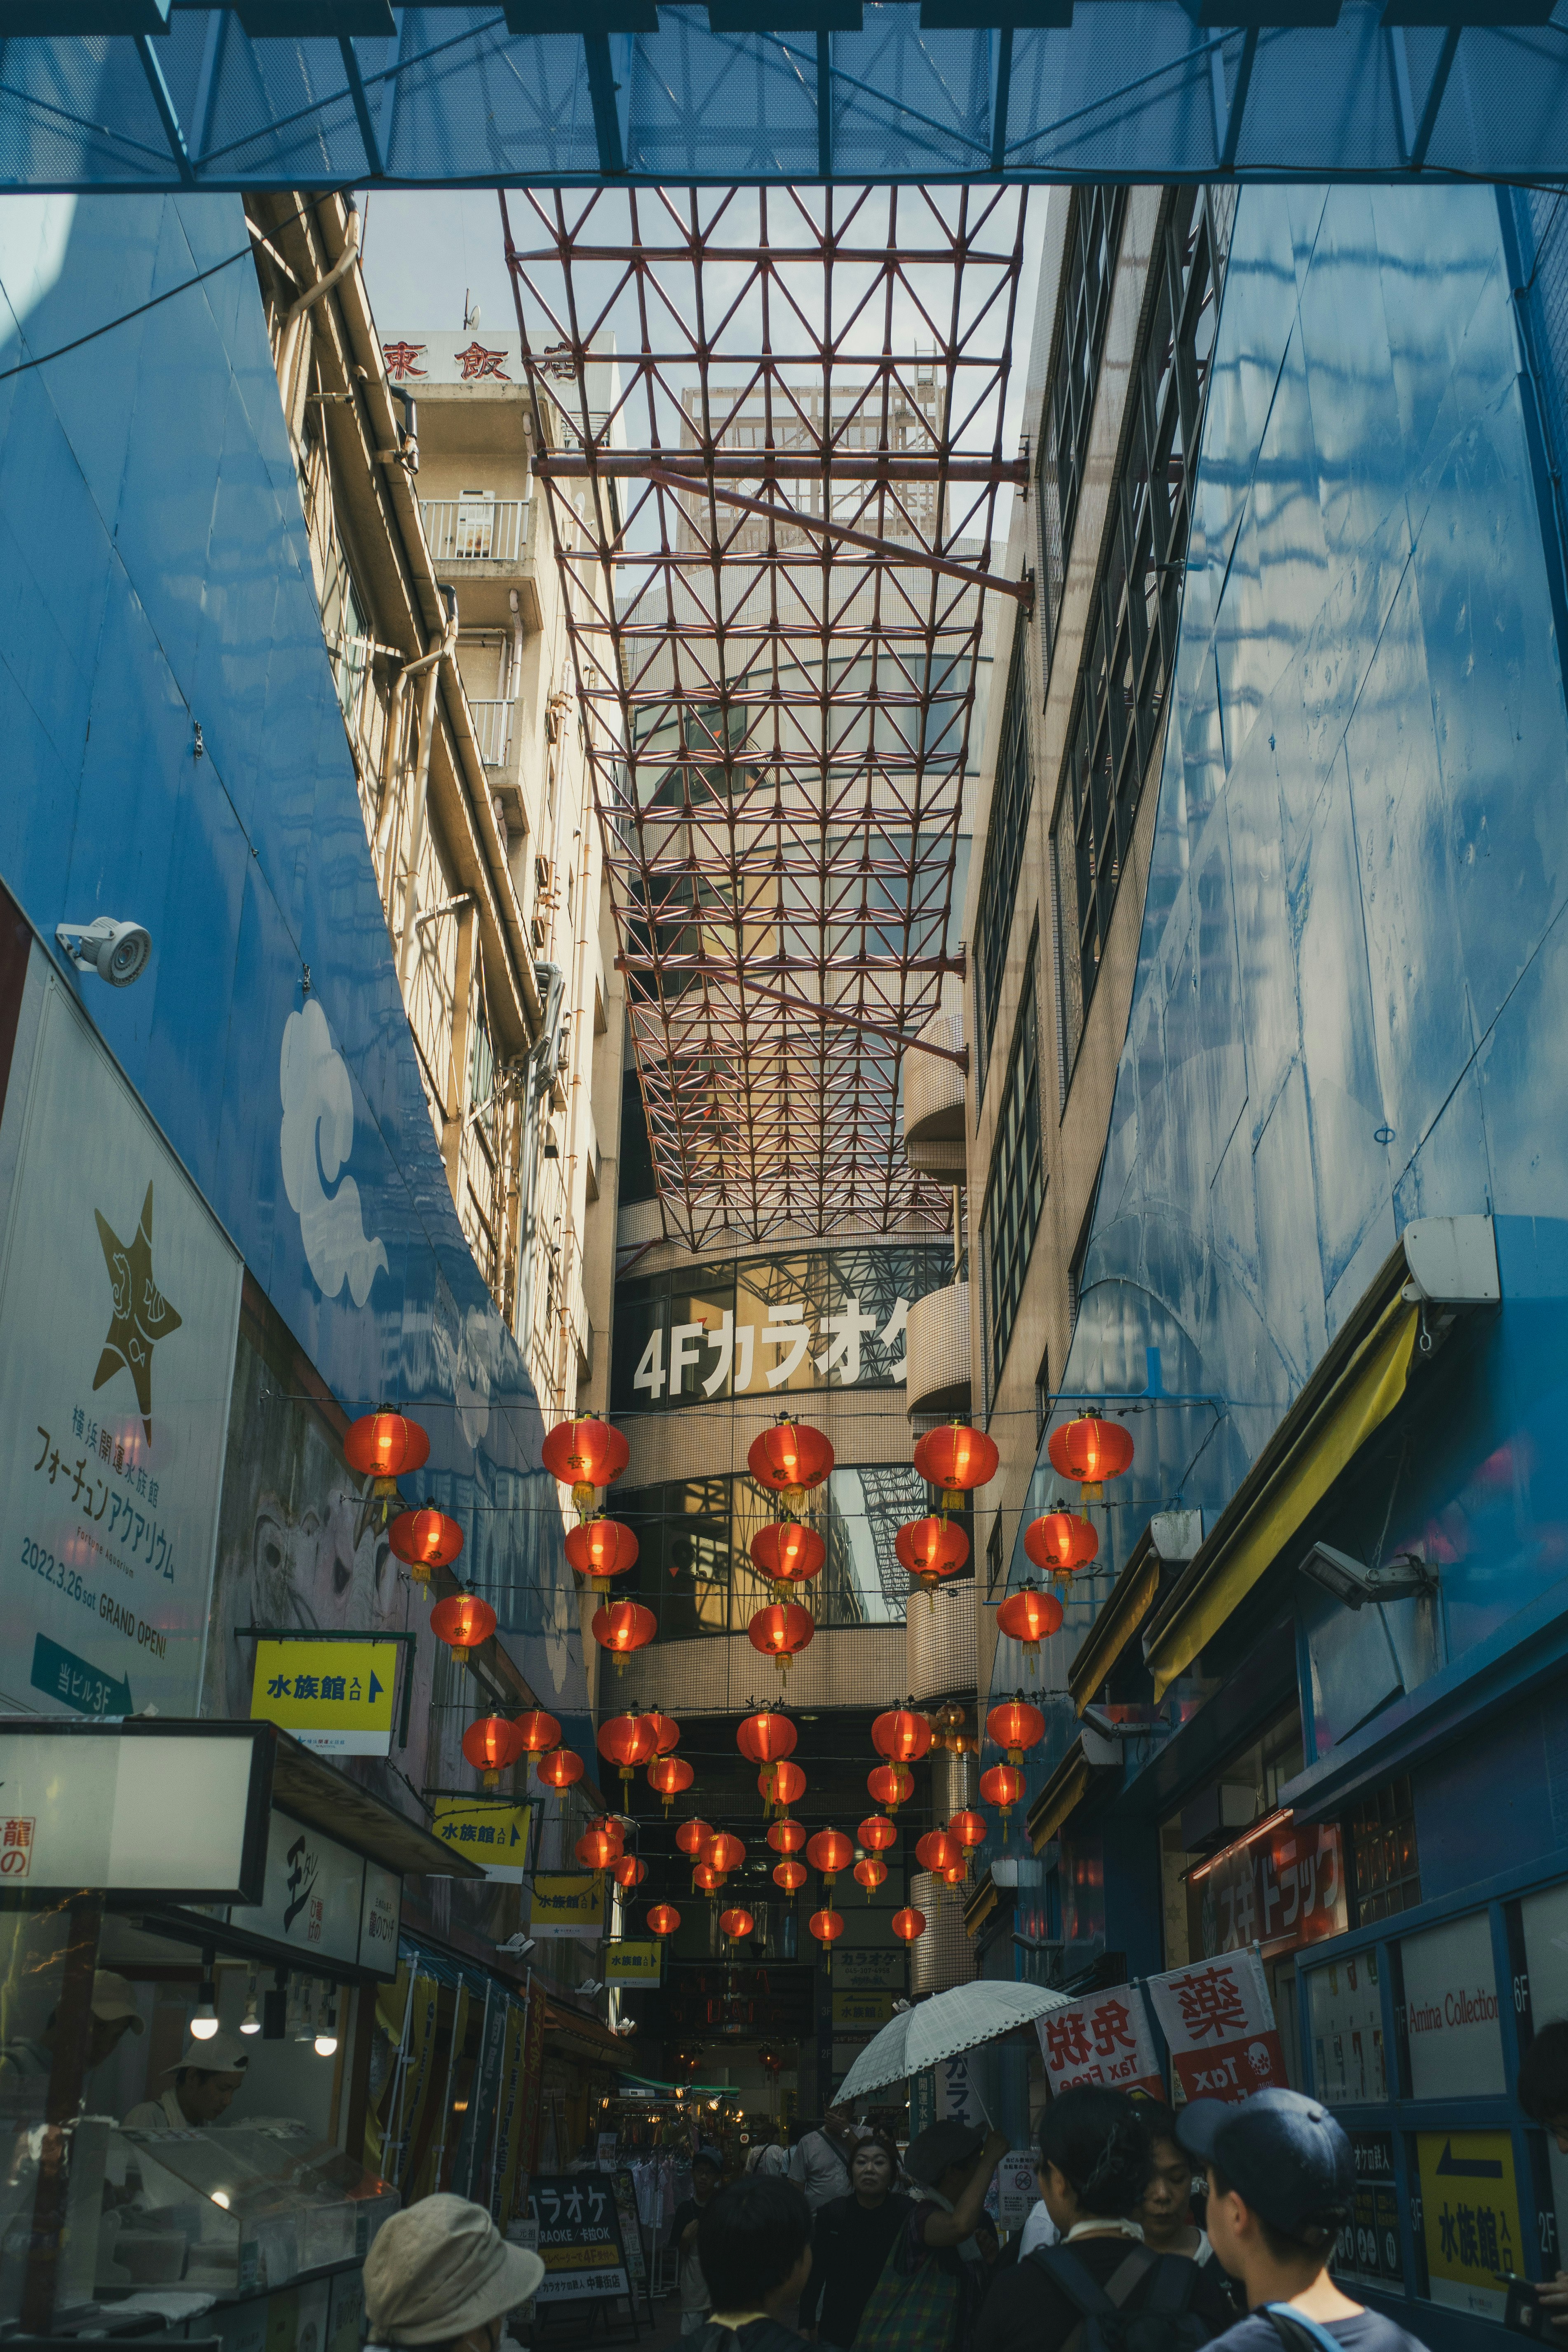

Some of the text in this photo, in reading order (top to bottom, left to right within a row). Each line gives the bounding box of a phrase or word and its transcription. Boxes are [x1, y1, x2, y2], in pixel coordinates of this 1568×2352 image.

[72, 1404, 160, 1509] 横浜開運水族館
[34, 1425, 175, 1584] フォーチュンアクアリウム
[77, 1526, 134, 1579] Fortune Aquarium
[99, 1593, 135, 1637] GRAND
[137, 1620, 167, 1660] OPEN!
[57, 1662, 111, 1714] 当ビル3F
[1221, 1823, 1341, 1954] スギドラッグ
[369, 1910, 395, 1943] 龍のひげ
[842, 1952, 897, 1966] カラオケ
[822, 2007, 832, 2016] 3F
[1409, 1988, 1499, 2034] Amina Collection
[1513, 1974, 1528, 2013] 6F
[821, 2049, 832, 2058] 2F
[1410, 2196, 1423, 2232] 3F
[1538, 2211, 1555, 2253] 2F
[539, 2229, 573, 2243] RAOKE
[587, 2275, 620, 2290] 中華街店
